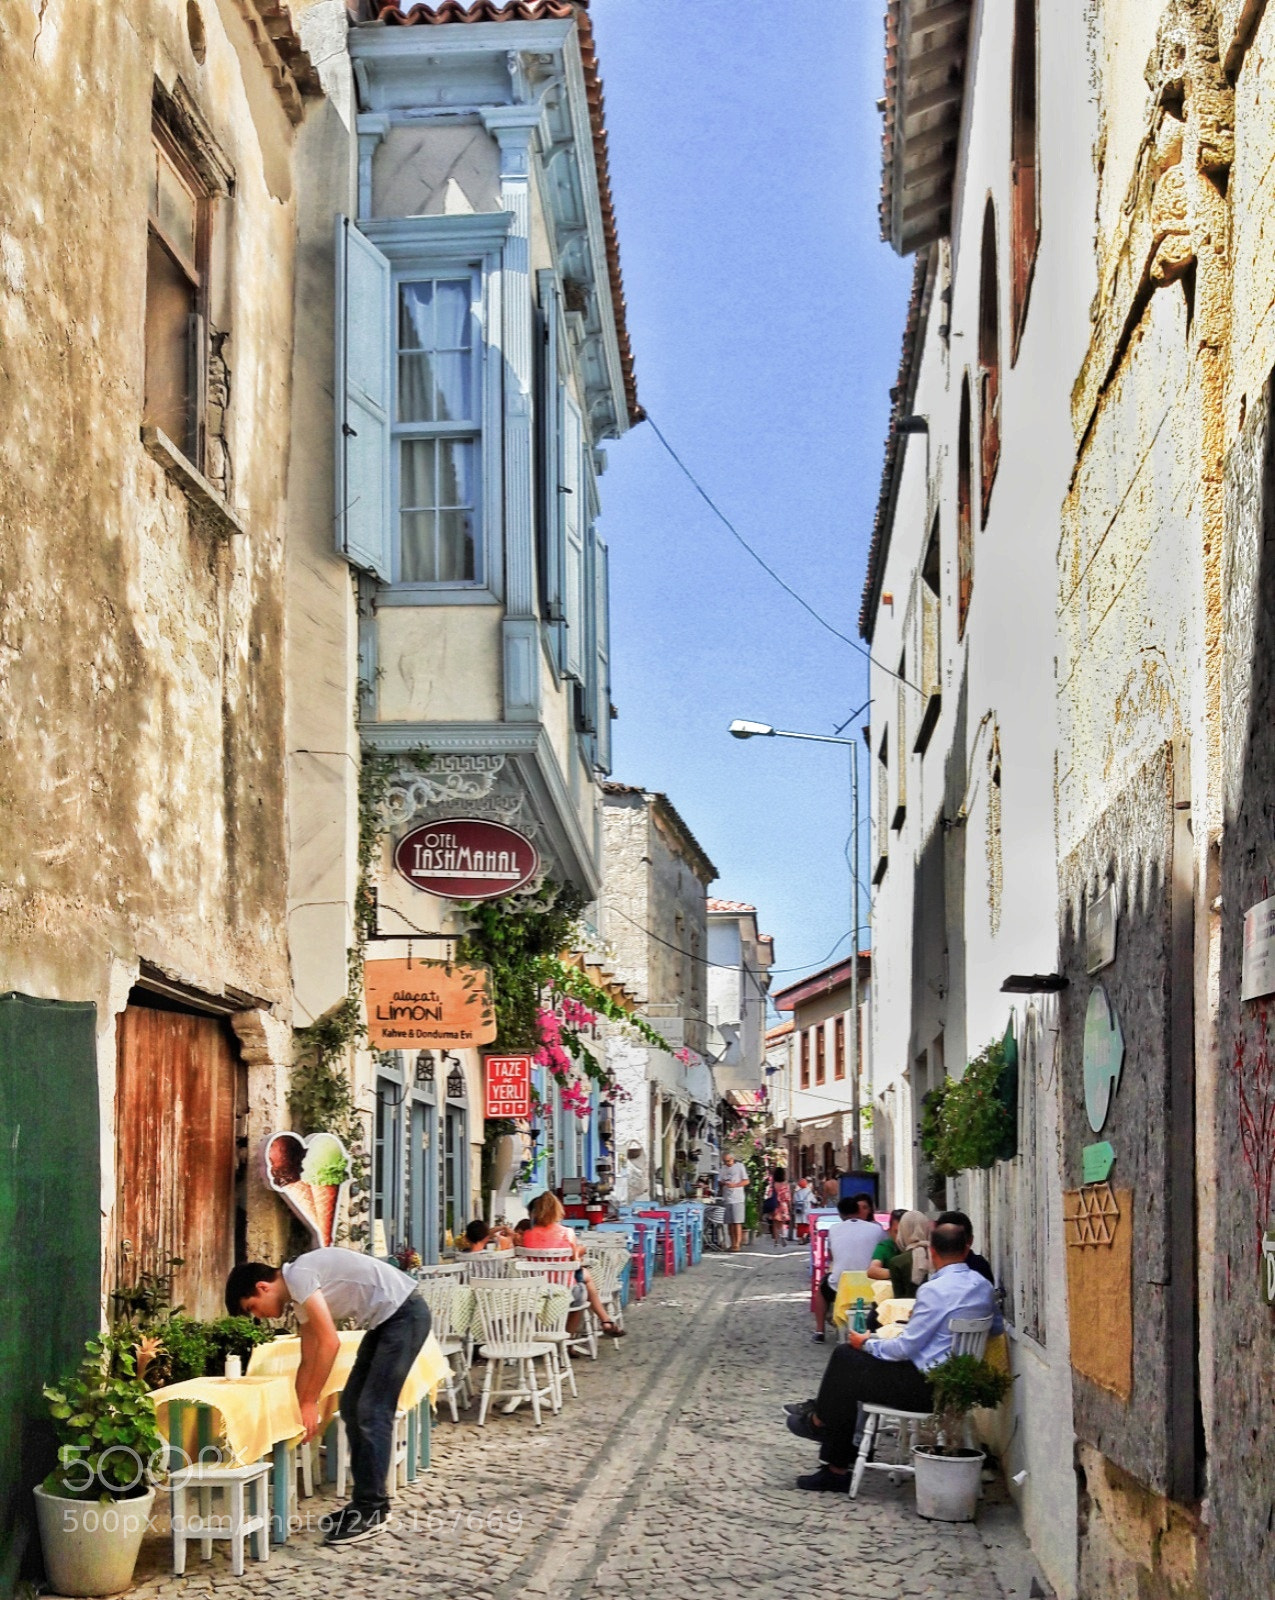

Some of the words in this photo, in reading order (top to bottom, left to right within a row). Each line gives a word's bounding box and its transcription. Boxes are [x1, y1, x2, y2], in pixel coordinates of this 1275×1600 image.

[425, 833, 458, 849] OTEL
[413, 844, 521, 872] TASHMAHAL
[382, 1028, 407, 1038] Kahve
[408, 1029, 414, 1038] &
[416, 1029, 459, 1039] Dondurma
[460, 1030, 473, 1040] Evi
[494, 1062, 522, 1077] TAZE
